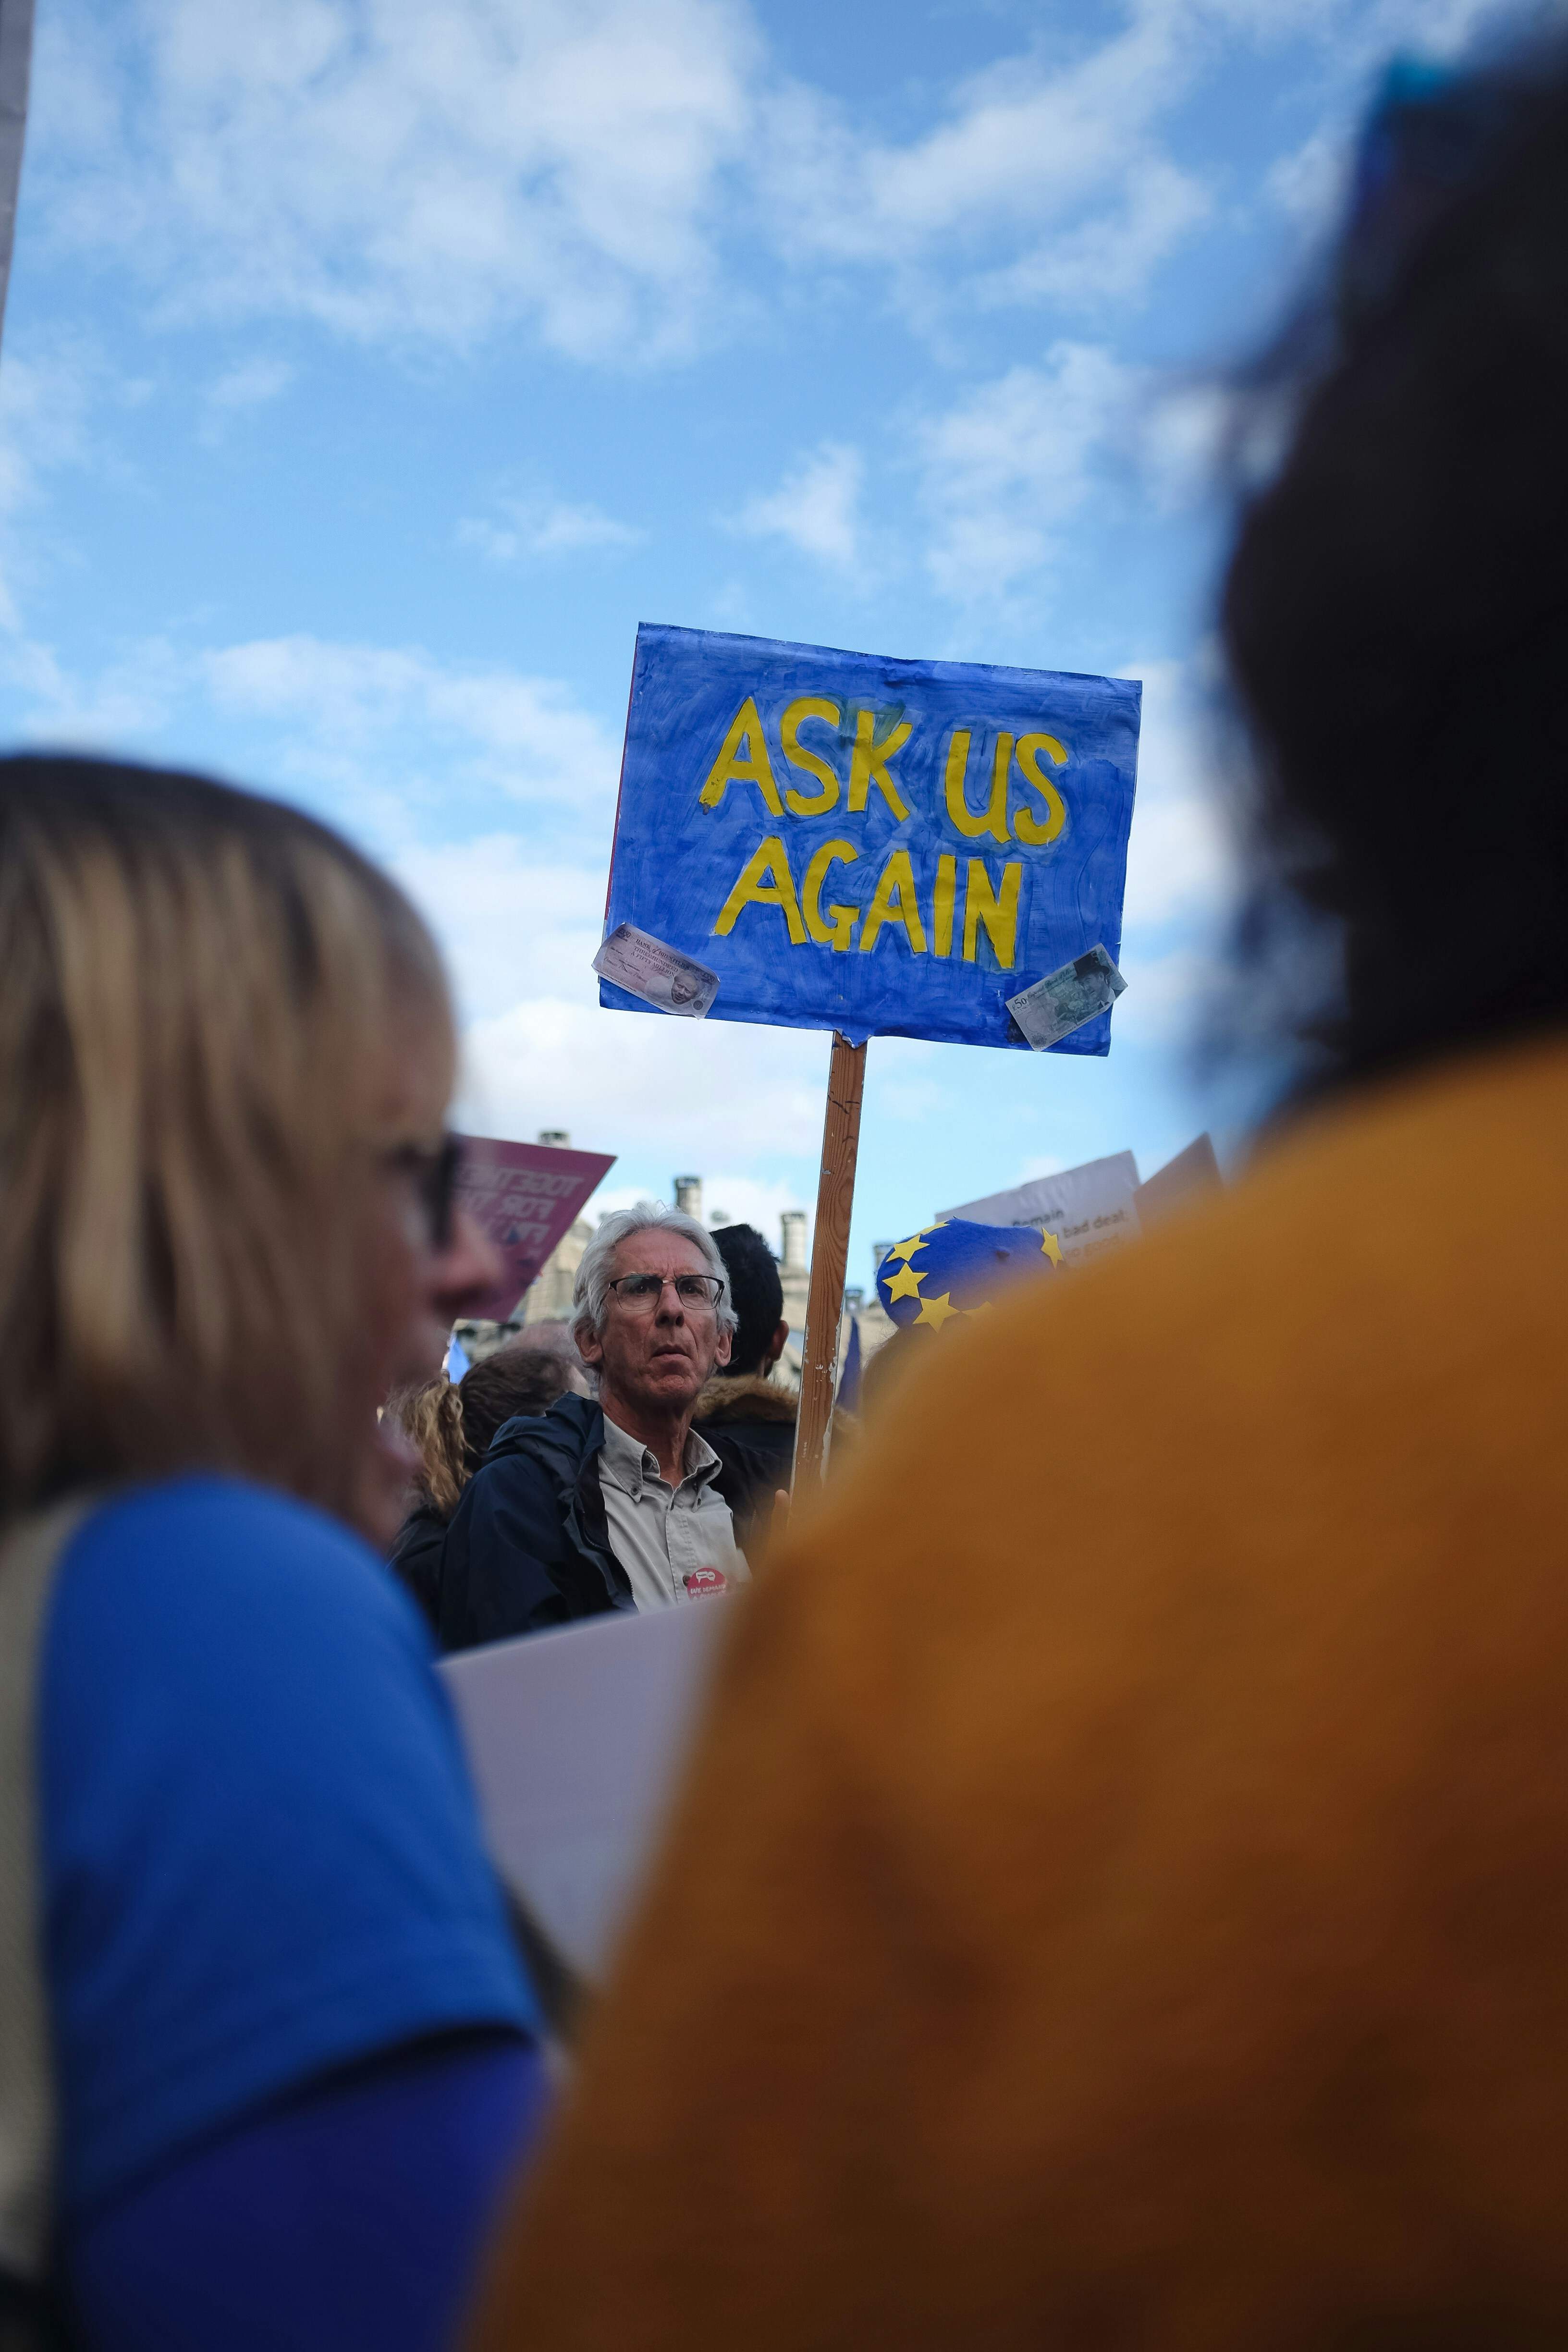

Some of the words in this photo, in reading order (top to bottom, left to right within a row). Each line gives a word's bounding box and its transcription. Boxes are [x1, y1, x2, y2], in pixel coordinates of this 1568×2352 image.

[699, 696, 912, 822] ASK
[945, 728, 1068, 846] US
[714, 836, 1022, 969] AGAIN
[635, 938, 651, 950] BANK
[636, 954, 652, 964] FIFTY
[652, 962, 675, 977] MILLION
[651, 955, 679, 972] HUNDRED
[1063, 1218, 1090, 1238] bad
